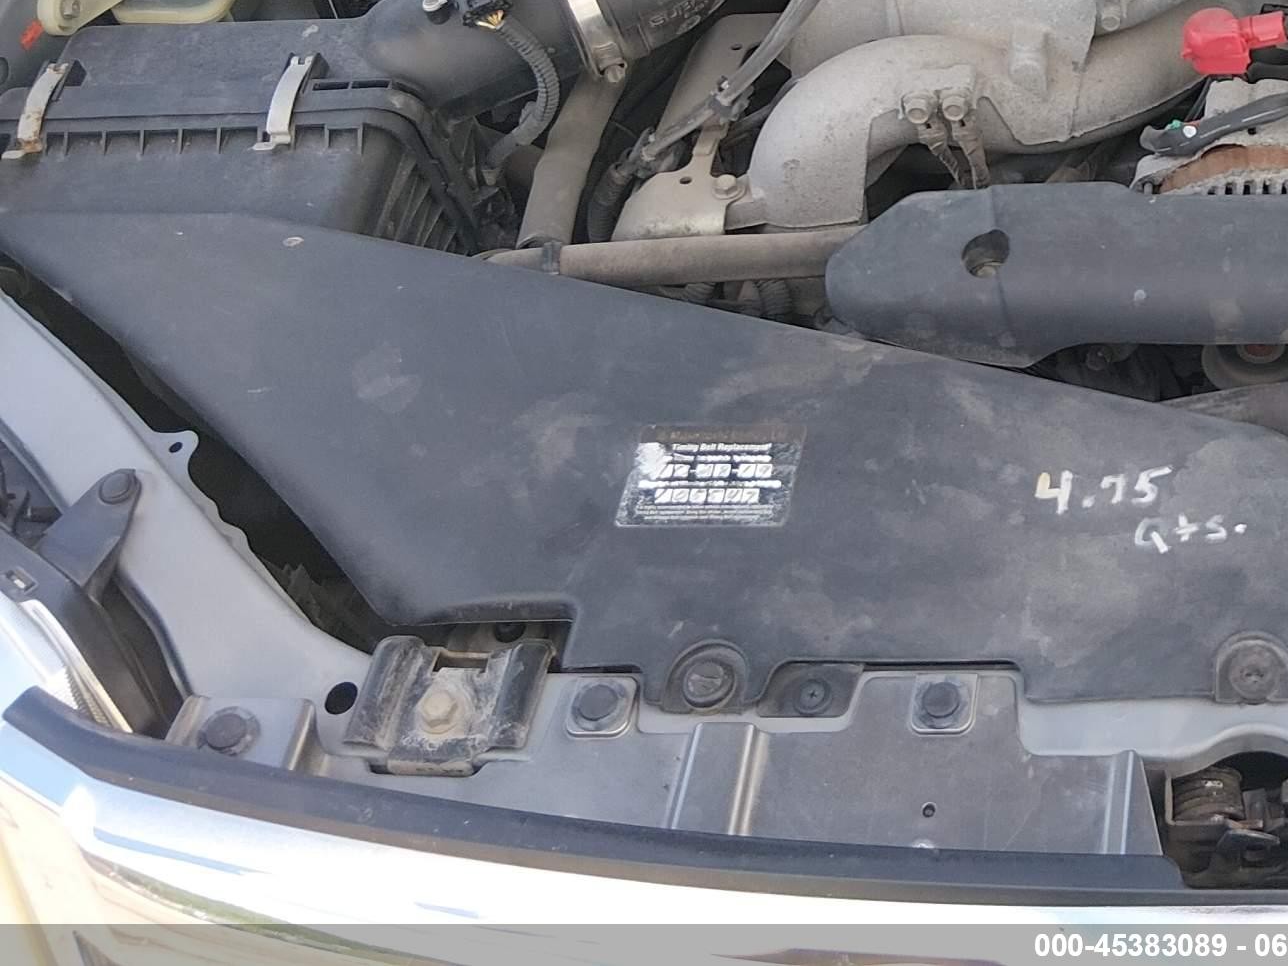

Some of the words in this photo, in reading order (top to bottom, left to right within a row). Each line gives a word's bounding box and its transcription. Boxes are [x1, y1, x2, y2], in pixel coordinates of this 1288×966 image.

[672, 443, 699, 453] Timing
[717, 442, 773, 452] Replacement
[1034, 464, 1174, 515] 4.75
